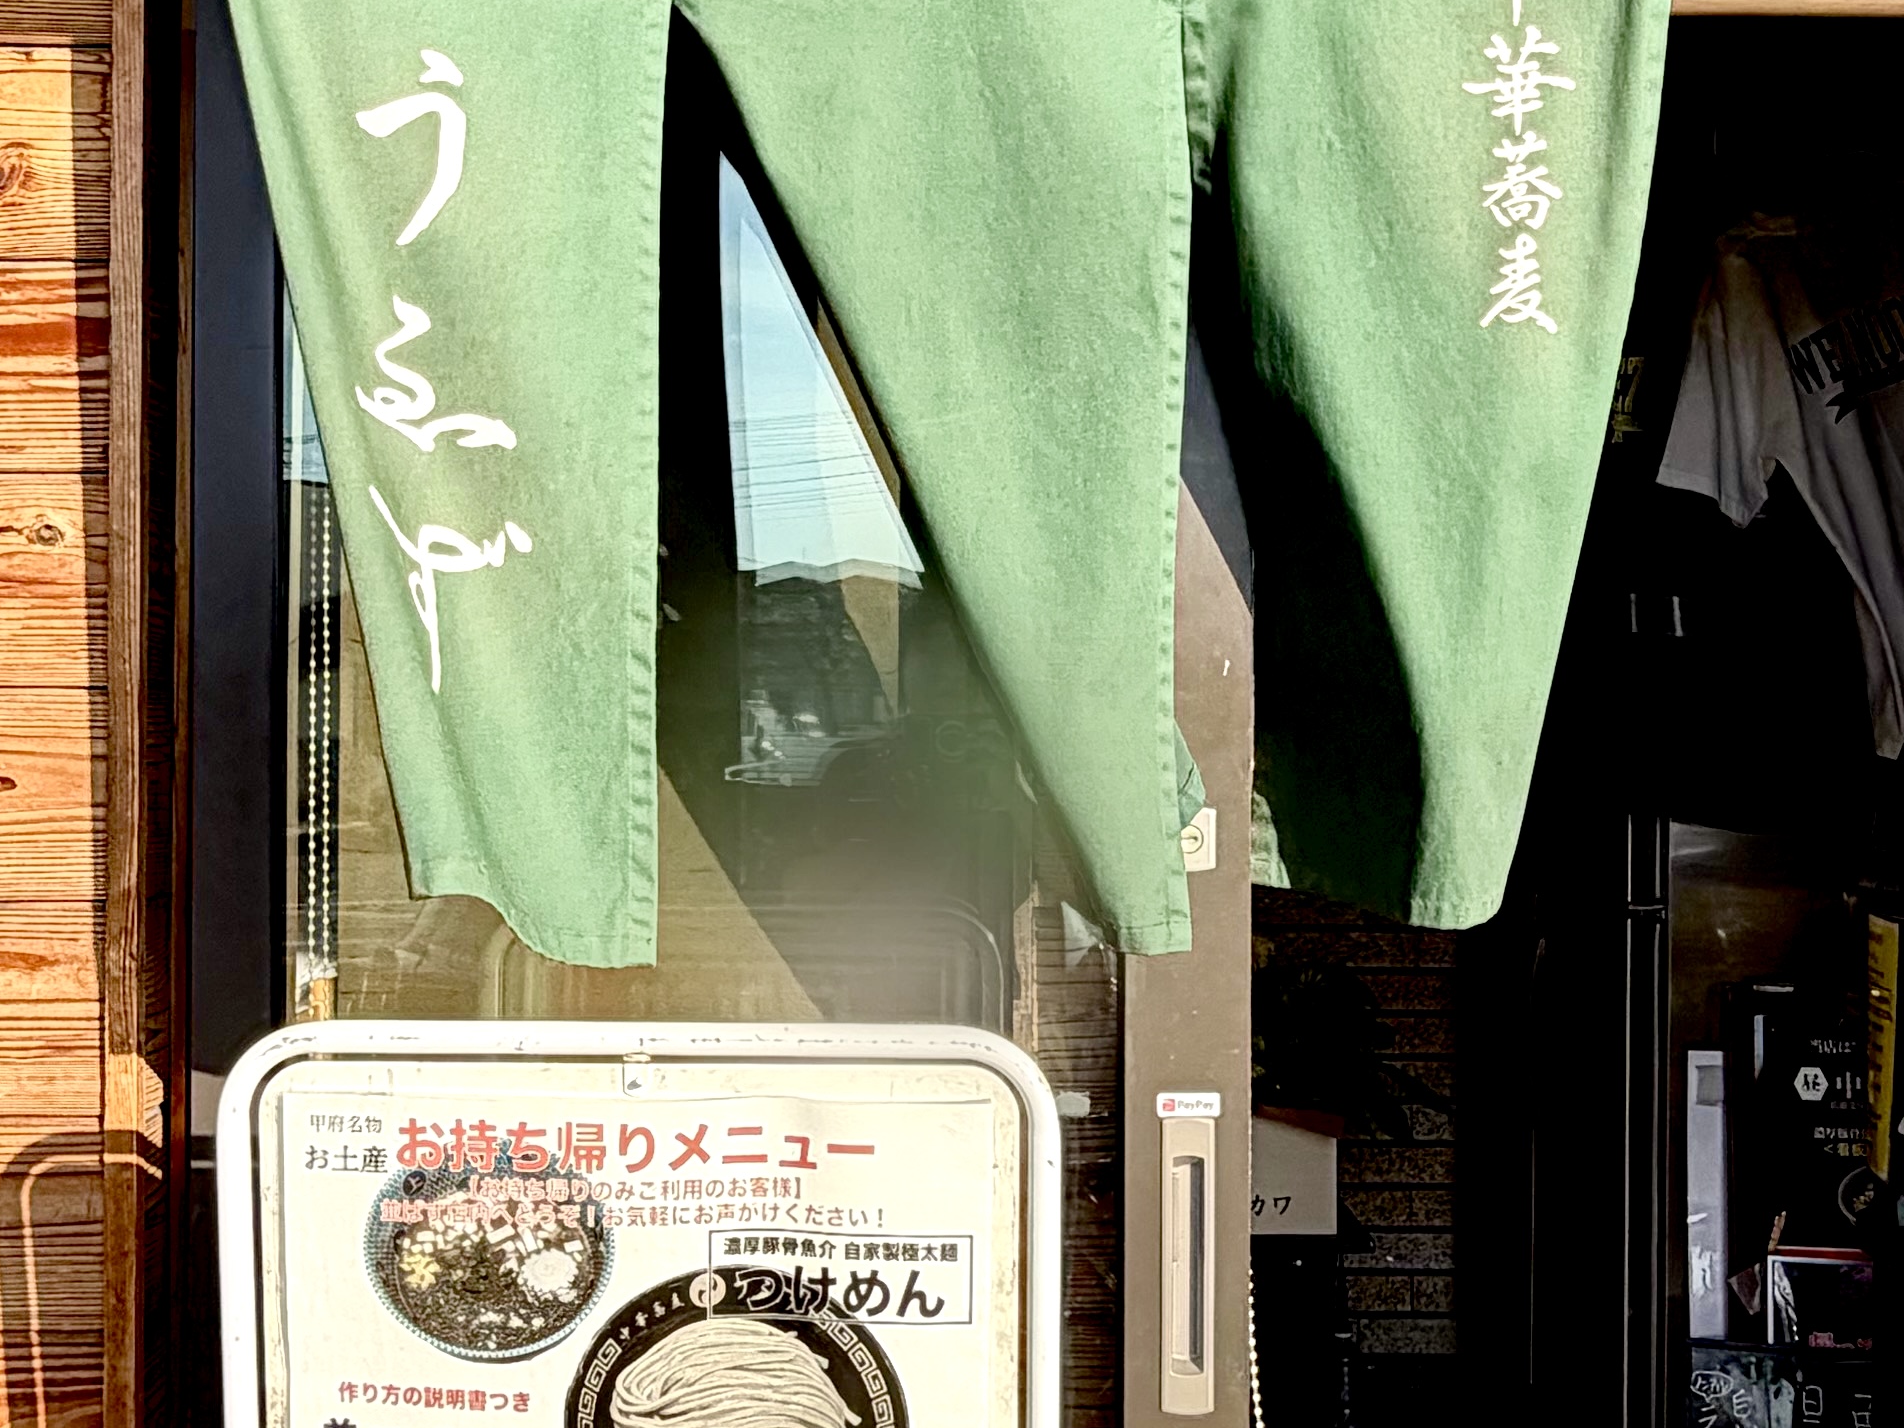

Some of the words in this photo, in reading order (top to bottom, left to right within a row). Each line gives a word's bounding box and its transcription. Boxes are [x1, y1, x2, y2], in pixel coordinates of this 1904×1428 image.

[1177, 1099, 1214, 1111] PayPay
[309, 1114, 383, 1134] 甲府名物
[396, 1118, 875, 1174] お持ち帰りメニュー
[304, 1145, 388, 1174] お土産
[723, 1237, 837, 1260] 濃厚豚骨魚介
[844, 1241, 959, 1263] 自家製極太麺
[734, 1265, 945, 1319] つけめん
[338, 1381, 531, 1413] 作り方の説明書つき
